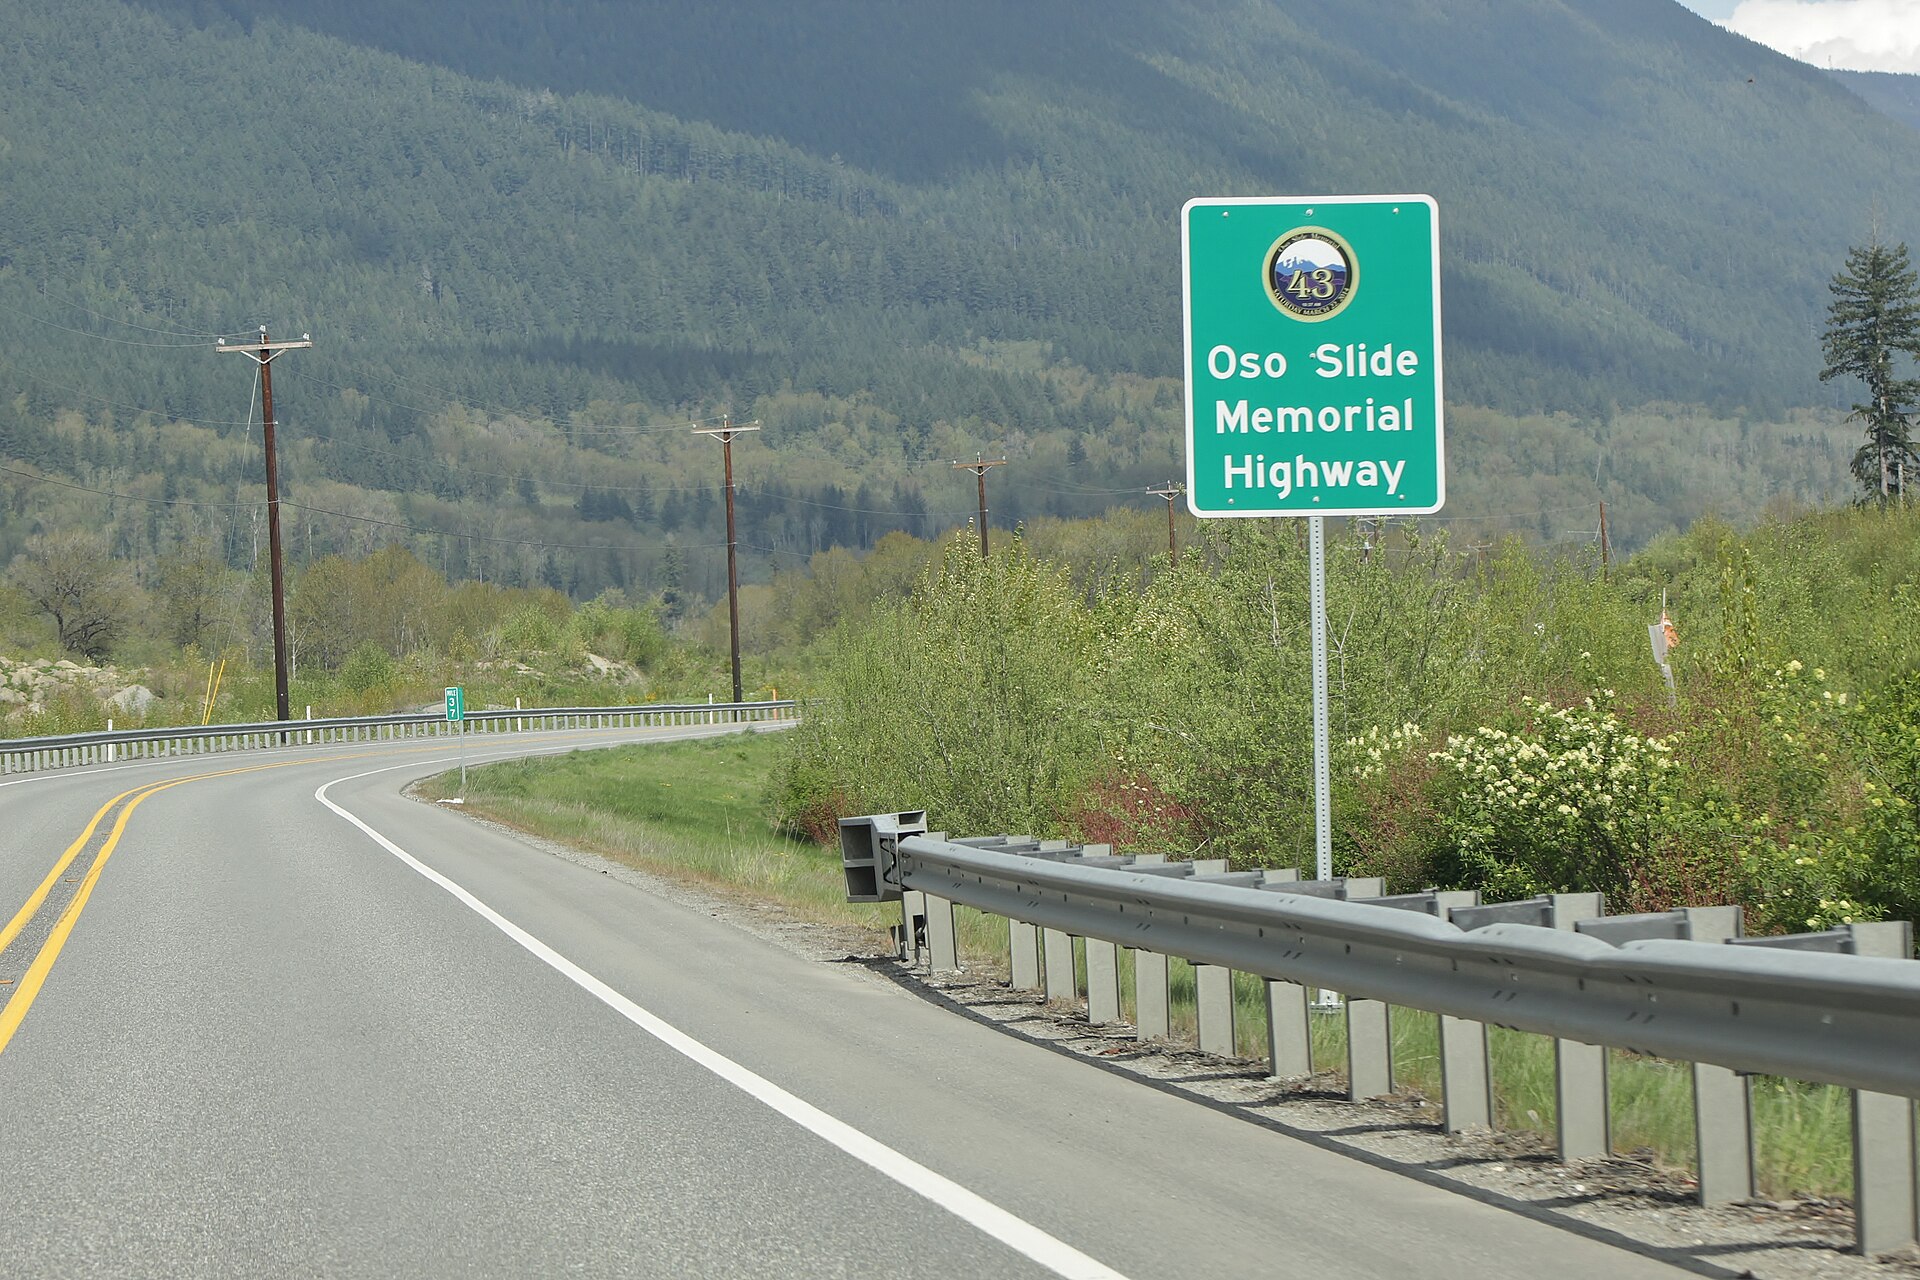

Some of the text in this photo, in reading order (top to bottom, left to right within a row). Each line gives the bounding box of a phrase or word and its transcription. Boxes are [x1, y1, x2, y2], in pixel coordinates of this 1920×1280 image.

[1287, 269, 1335, 299] 43
[1207, 343, 1419, 380] Oso Slide
[1216, 398, 1413, 434] Memorial
[1224, 454, 1406, 500] Highway
